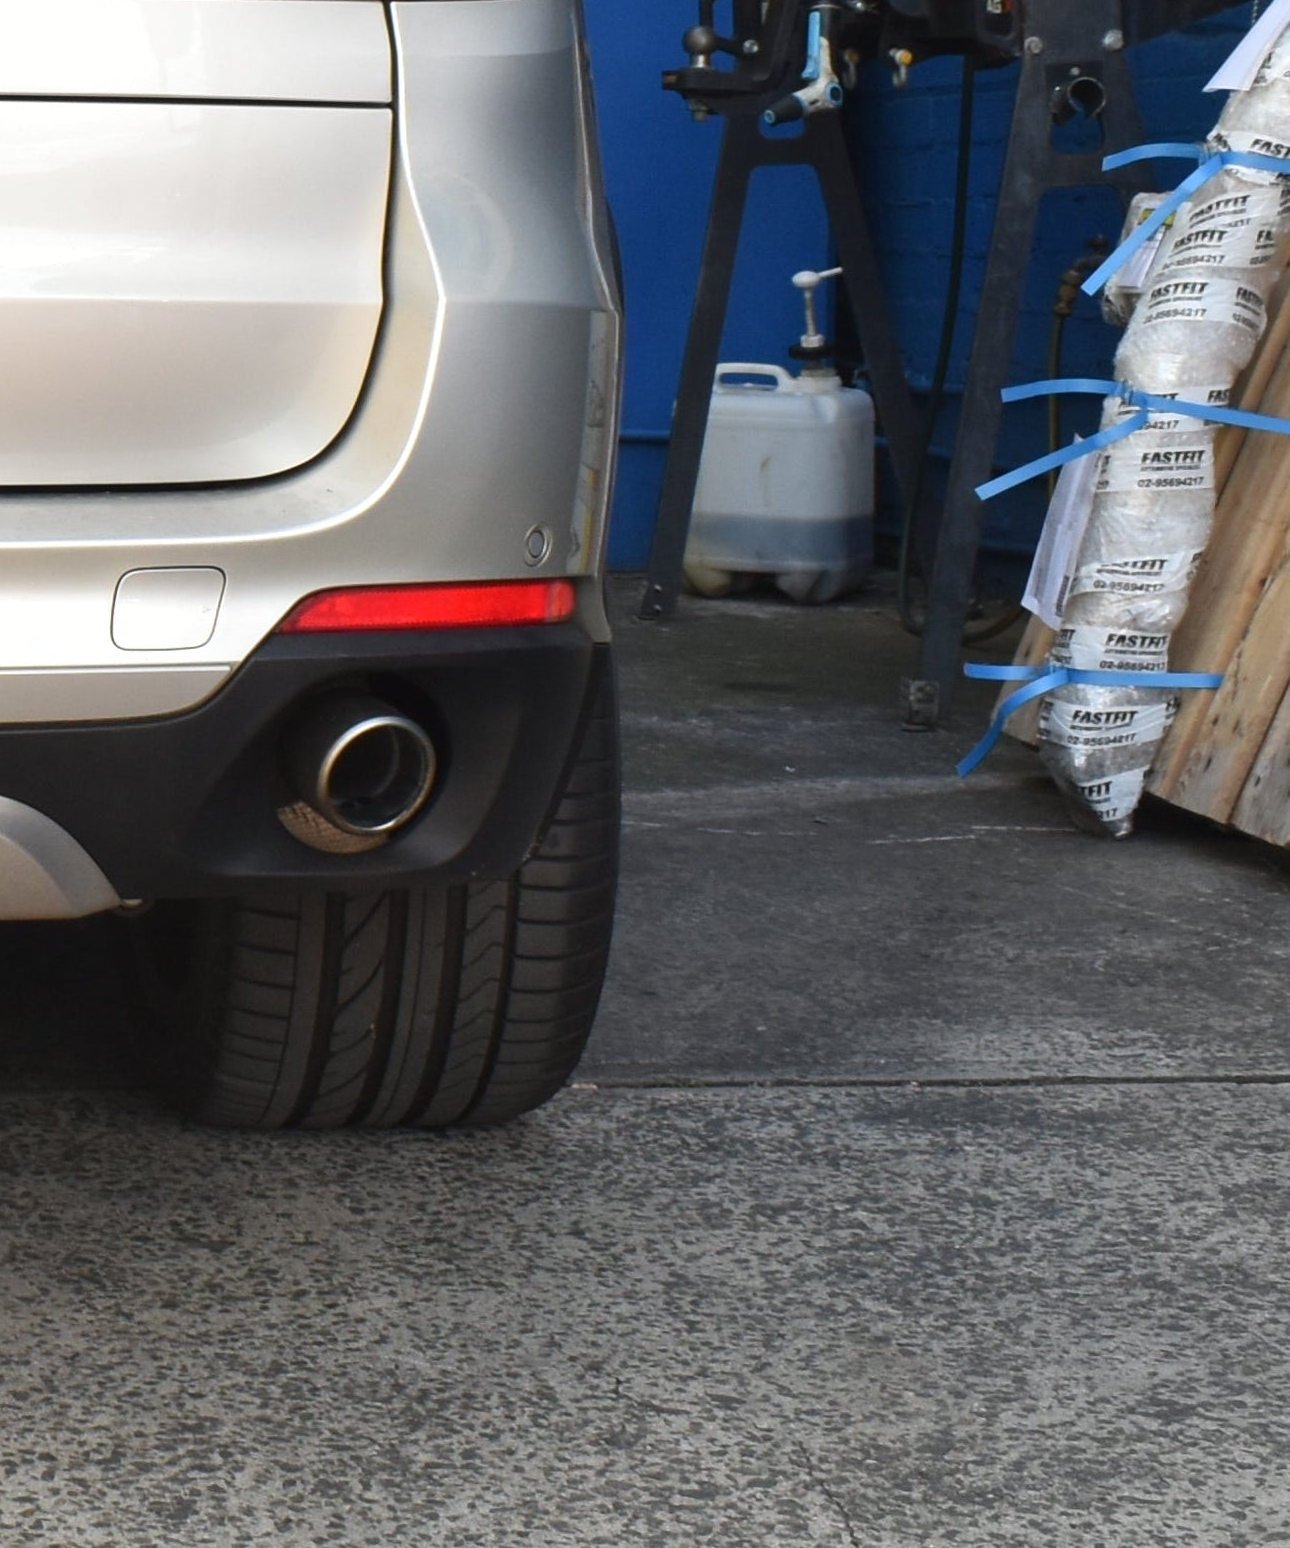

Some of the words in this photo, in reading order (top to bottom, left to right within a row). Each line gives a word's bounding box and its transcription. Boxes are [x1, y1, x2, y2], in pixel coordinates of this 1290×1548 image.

[1150, 282, 1209, 300] FASTFIT
[1140, 450, 1205, 464] FASTFIT
[1137, 476, 1205, 488] 02-95694217
[1105, 633, 1168, 649] FASTFIT
[1072, 710, 1138, 725] FASTFIT
